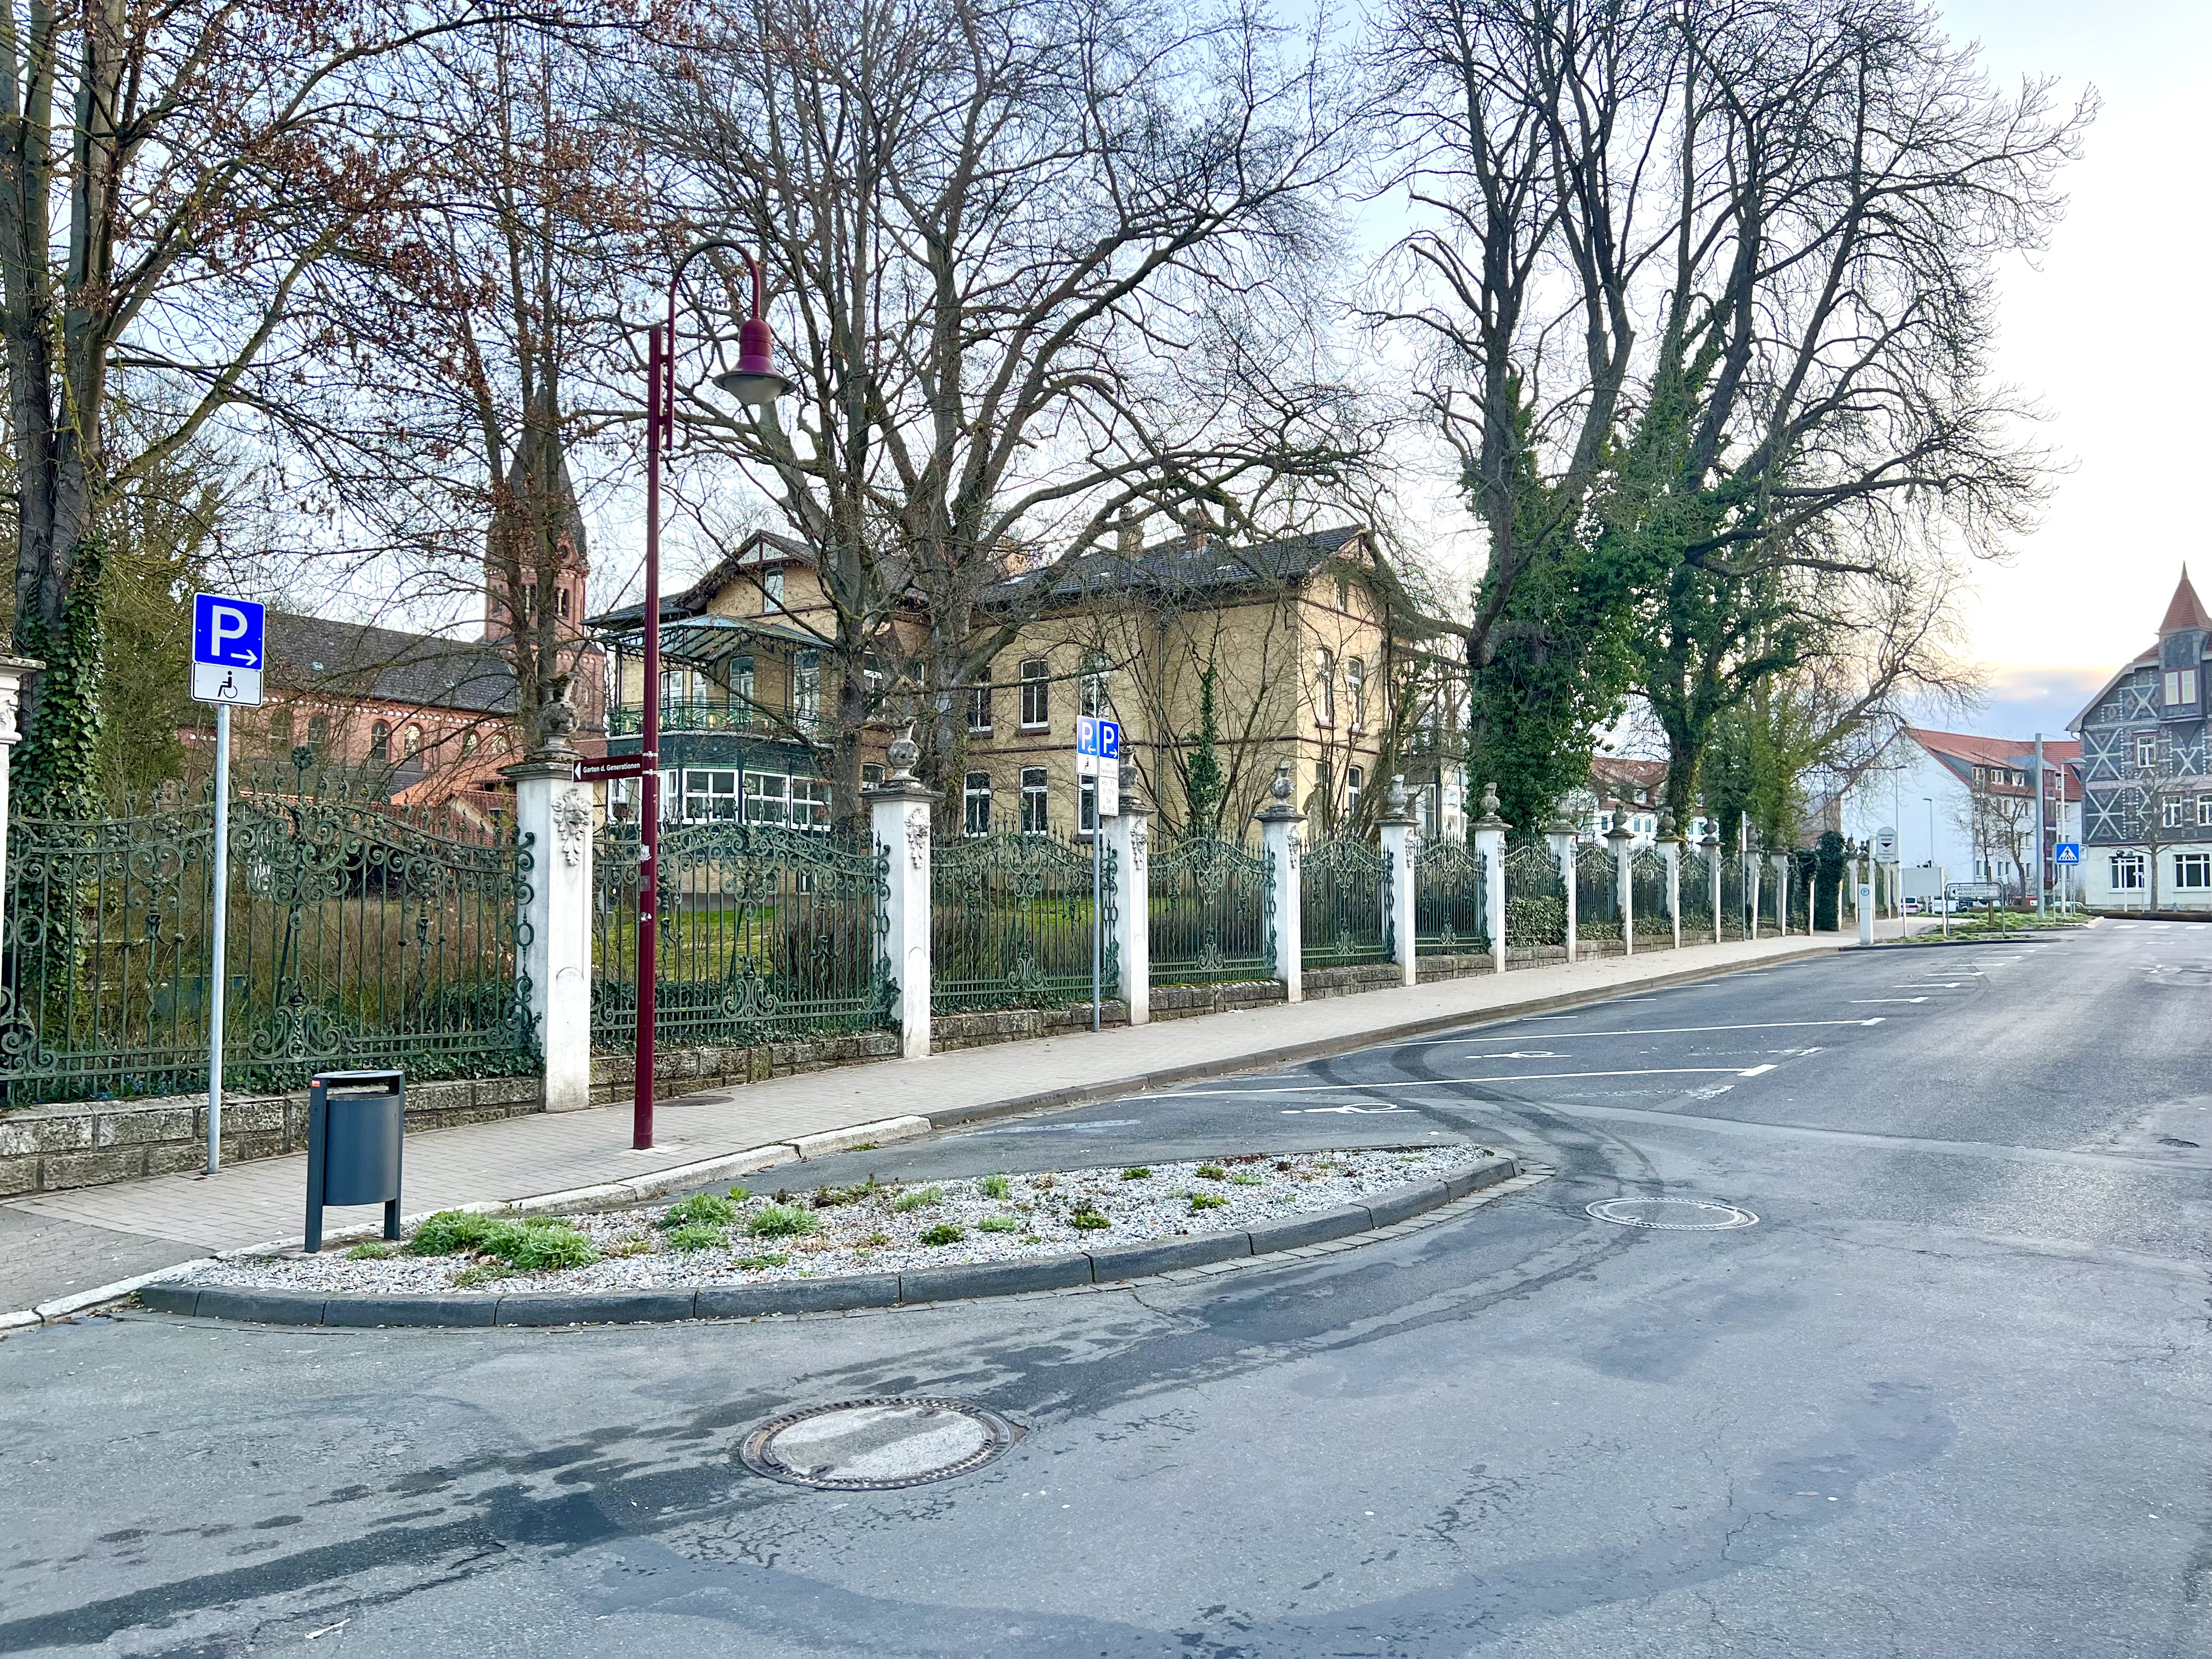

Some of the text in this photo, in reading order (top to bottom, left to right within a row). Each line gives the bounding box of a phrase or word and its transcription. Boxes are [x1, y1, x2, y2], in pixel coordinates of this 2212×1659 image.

[211, 605, 248, 657] P
[1081, 721, 1093, 750] P
[1103, 726, 1115, 754] P
[606, 762, 641, 771] Generationen
